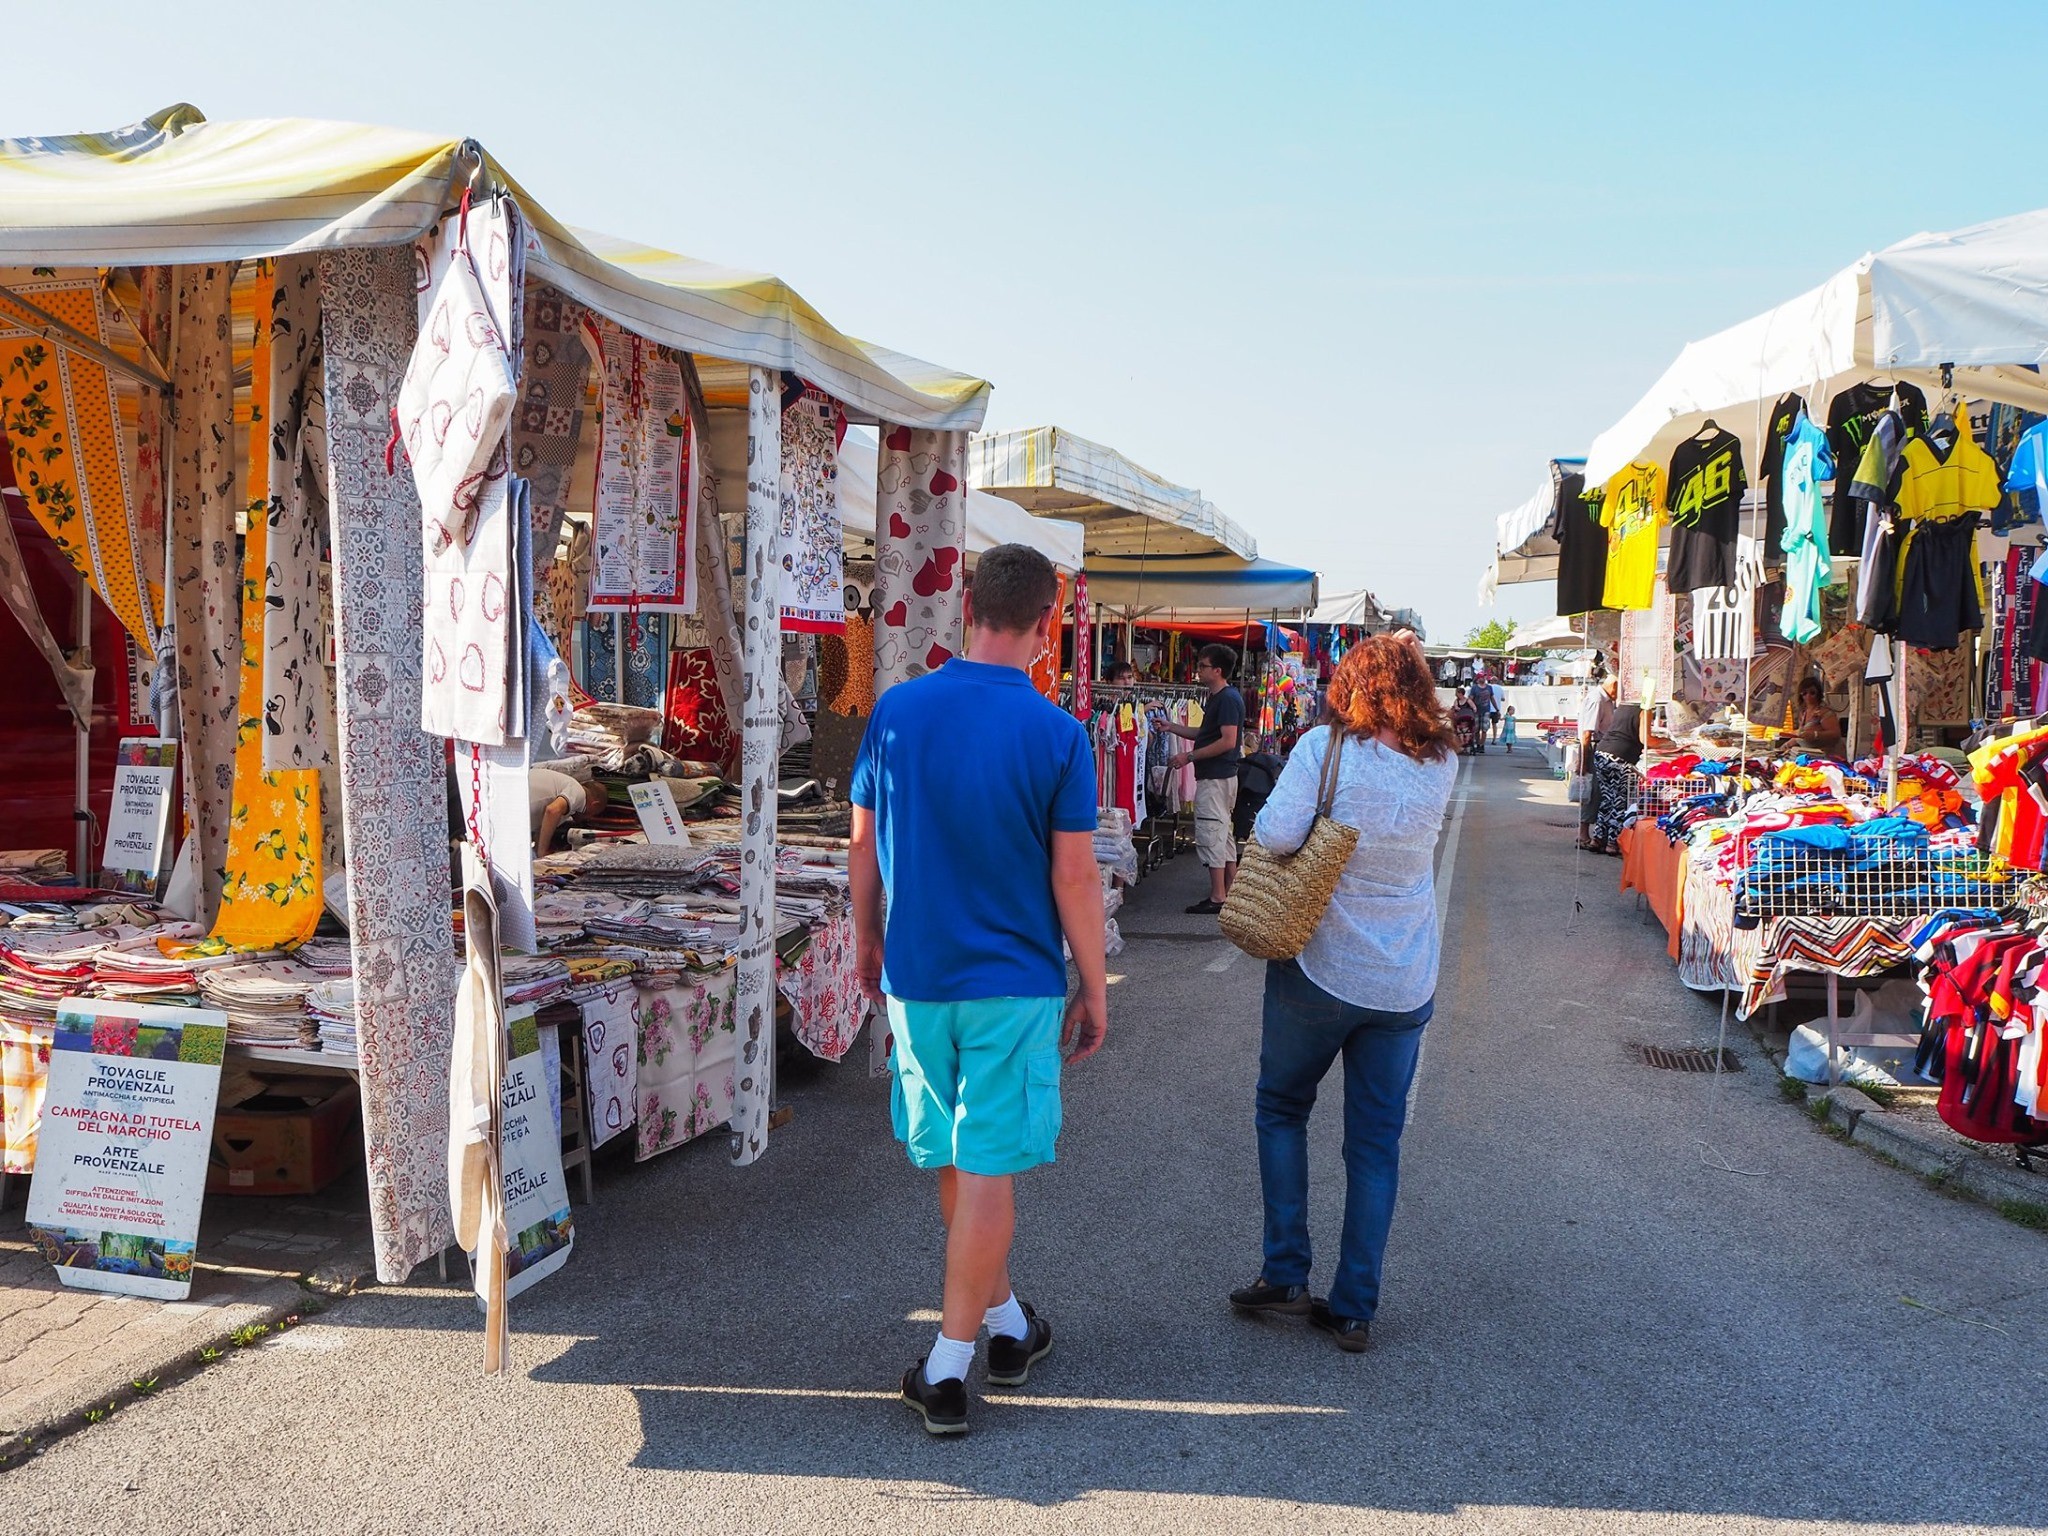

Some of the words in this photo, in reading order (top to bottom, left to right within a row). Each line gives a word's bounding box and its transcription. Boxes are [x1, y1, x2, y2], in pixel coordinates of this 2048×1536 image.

[1679, 451, 1733, 516] 46
[126, 774, 160, 785] TOVAGLIE
[119, 785, 164, 796] PROVENZALI
[126, 831, 143, 841] ARTE
[114, 839, 153, 851] PROVENZALE
[99, 1065, 167, 1082] TOVAGLIE
[87, 1076, 175, 1095] PROVENZALI
[83, 1090, 131, 1101] ANTIMACCHIA
[138, 1095, 176, 1106] ANTIPIEGA
[51, 1105, 129, 1124] CAMPAGNA
[132, 1114, 147, 1125] DI
[149, 1116, 202, 1132] TUTELA
[77, 1121, 104, 1133] DEL
[106, 1124, 171, 1141] MARCHIO
[102, 1145, 139, 1159] ARTE
[73, 1154, 165, 1175] PROVENZALE
[503, 1167, 526, 1189] RTE
[65, 1189, 101, 1199] DIFFIDATE
[102, 1194, 125, 1202] DALLE
[126, 1196, 164, 1207] IMITAZIONI
[92, 1186, 139, 1197] ATTENZIONE!
[62, 1201, 93, 1211] QUALITÀ
[126, 1209, 146, 1218] SOLO
[65, 1208, 98, 1217] MARCHIO
[118, 1214, 166, 1227] PROVENZALE
